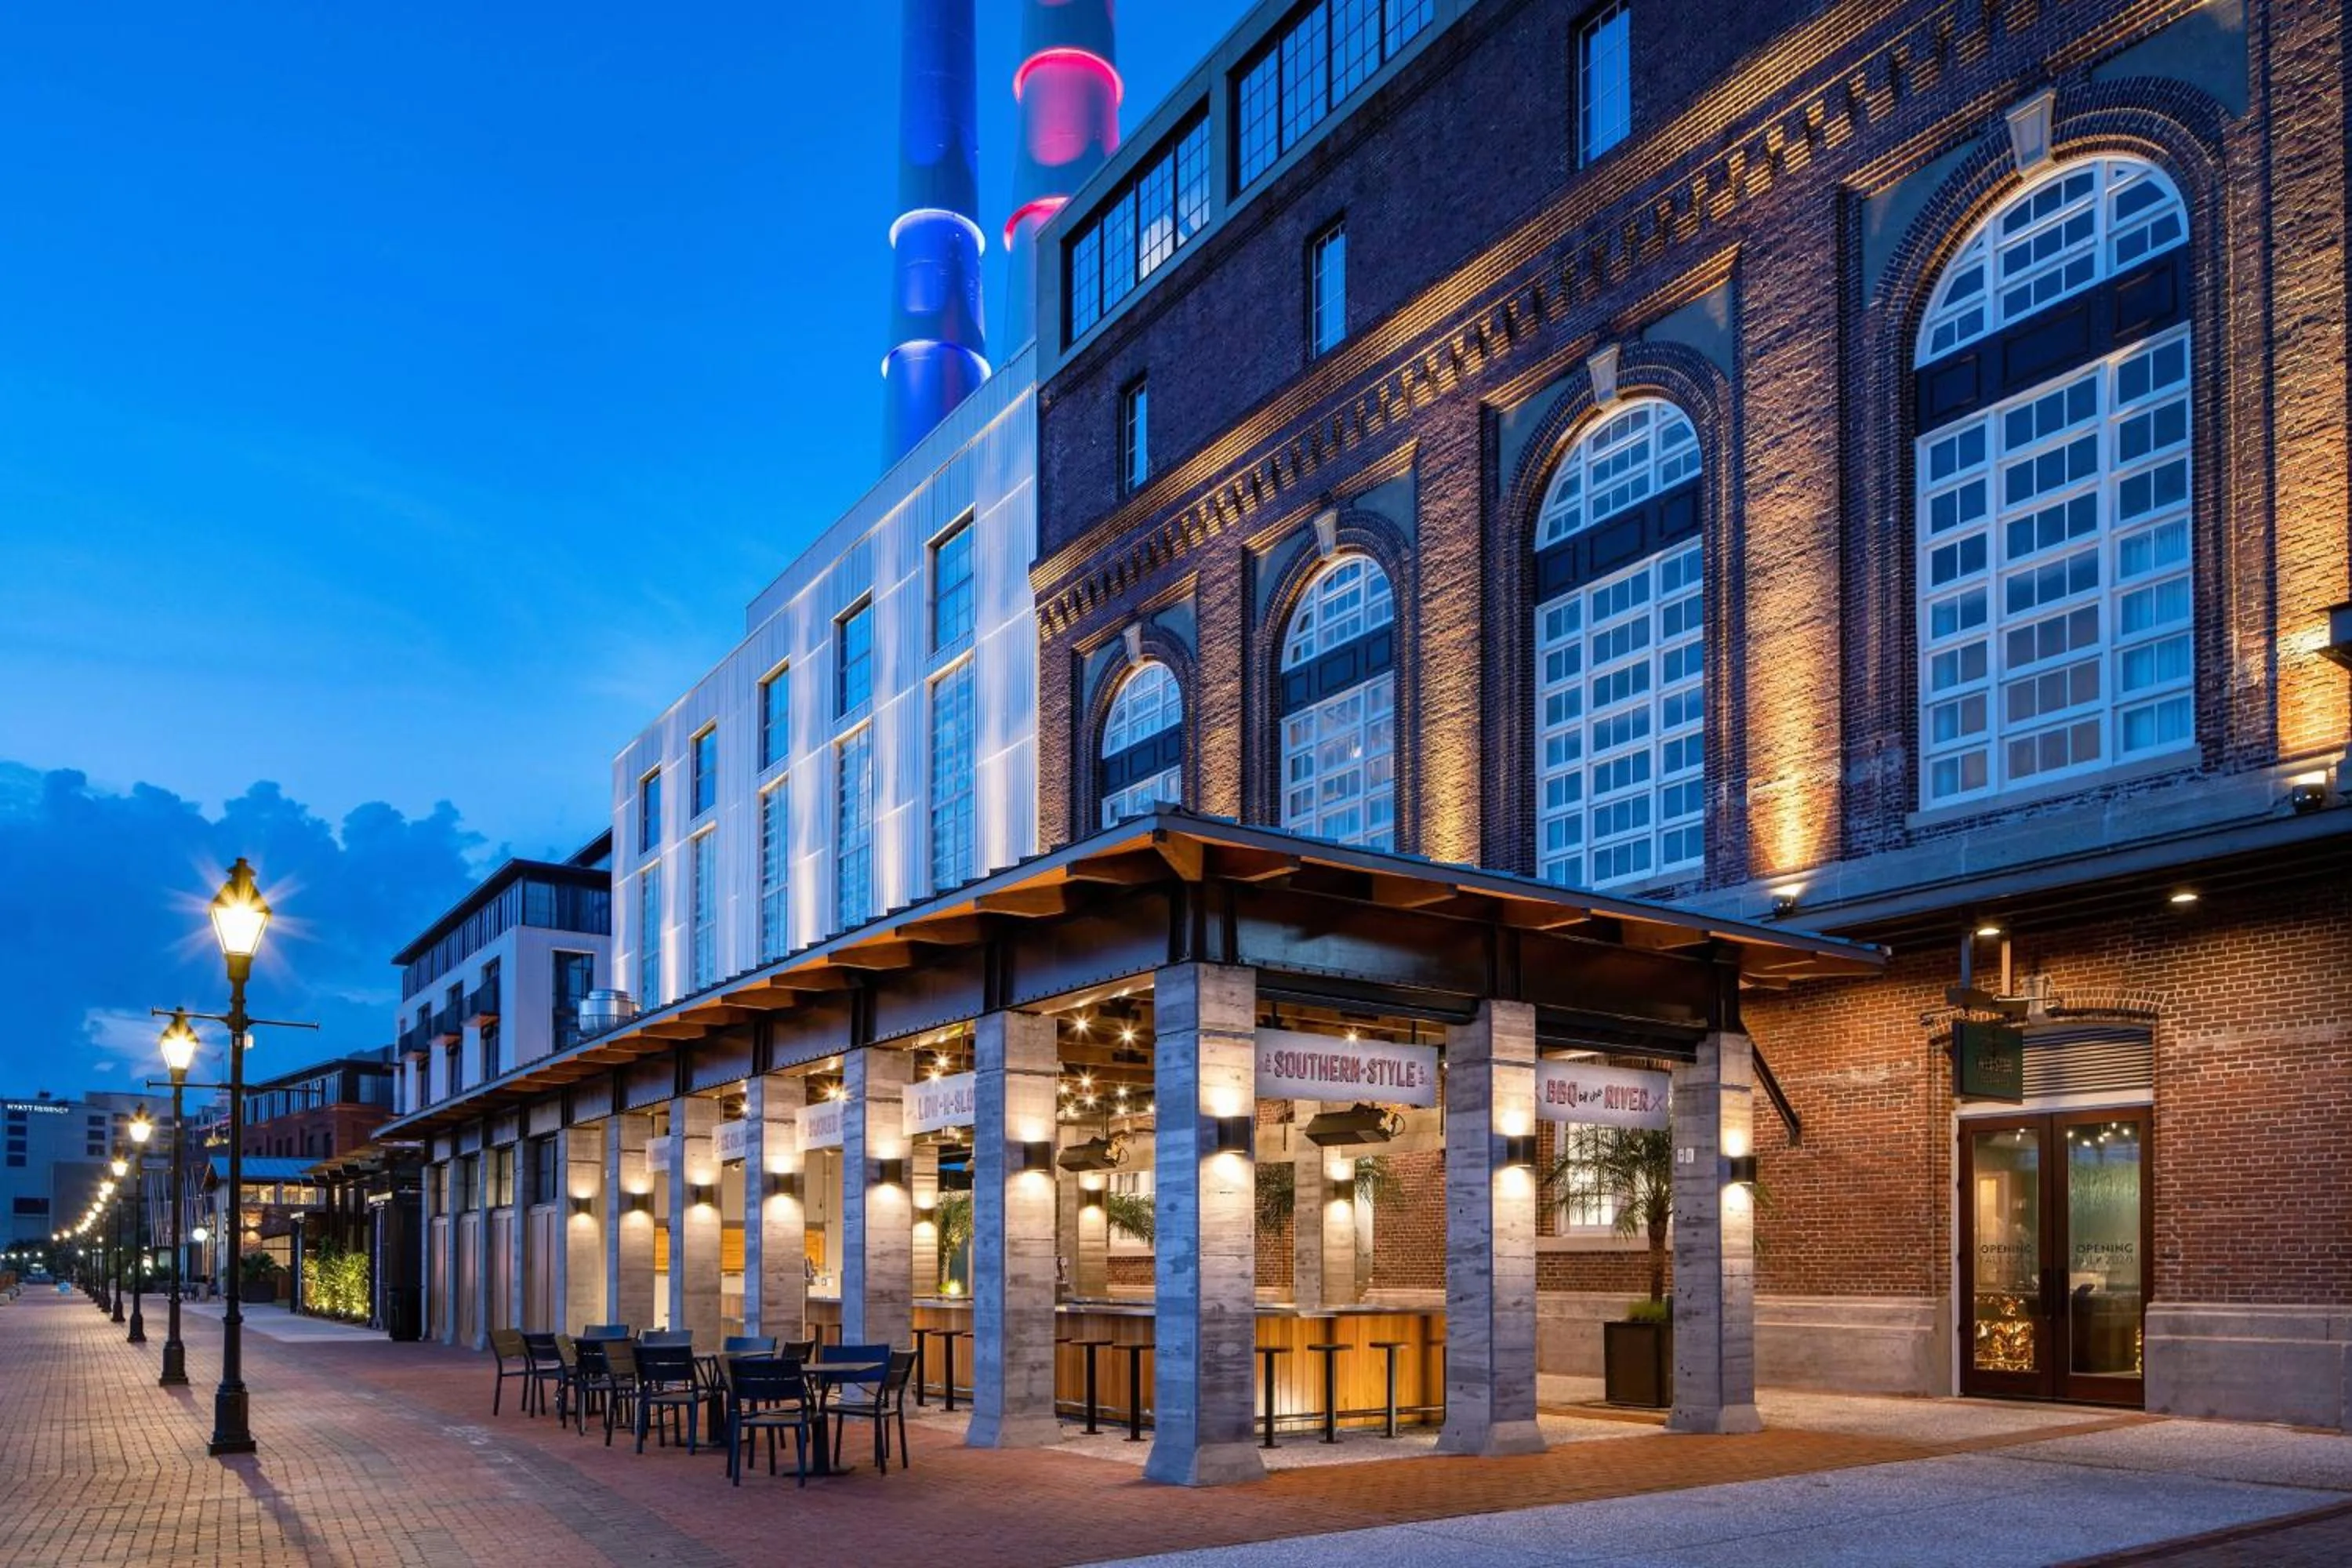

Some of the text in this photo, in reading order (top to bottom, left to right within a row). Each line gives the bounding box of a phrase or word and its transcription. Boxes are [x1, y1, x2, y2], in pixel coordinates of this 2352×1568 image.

[918, 1087, 974, 1120] LOW-N-SLO
[1546, 1079, 1578, 1108] BBQ
[1603, 1084, 1648, 1111] RIVER
[1980, 1244, 2033, 1254] OPENING
[2075, 1243, 2133, 1254] OPENING
